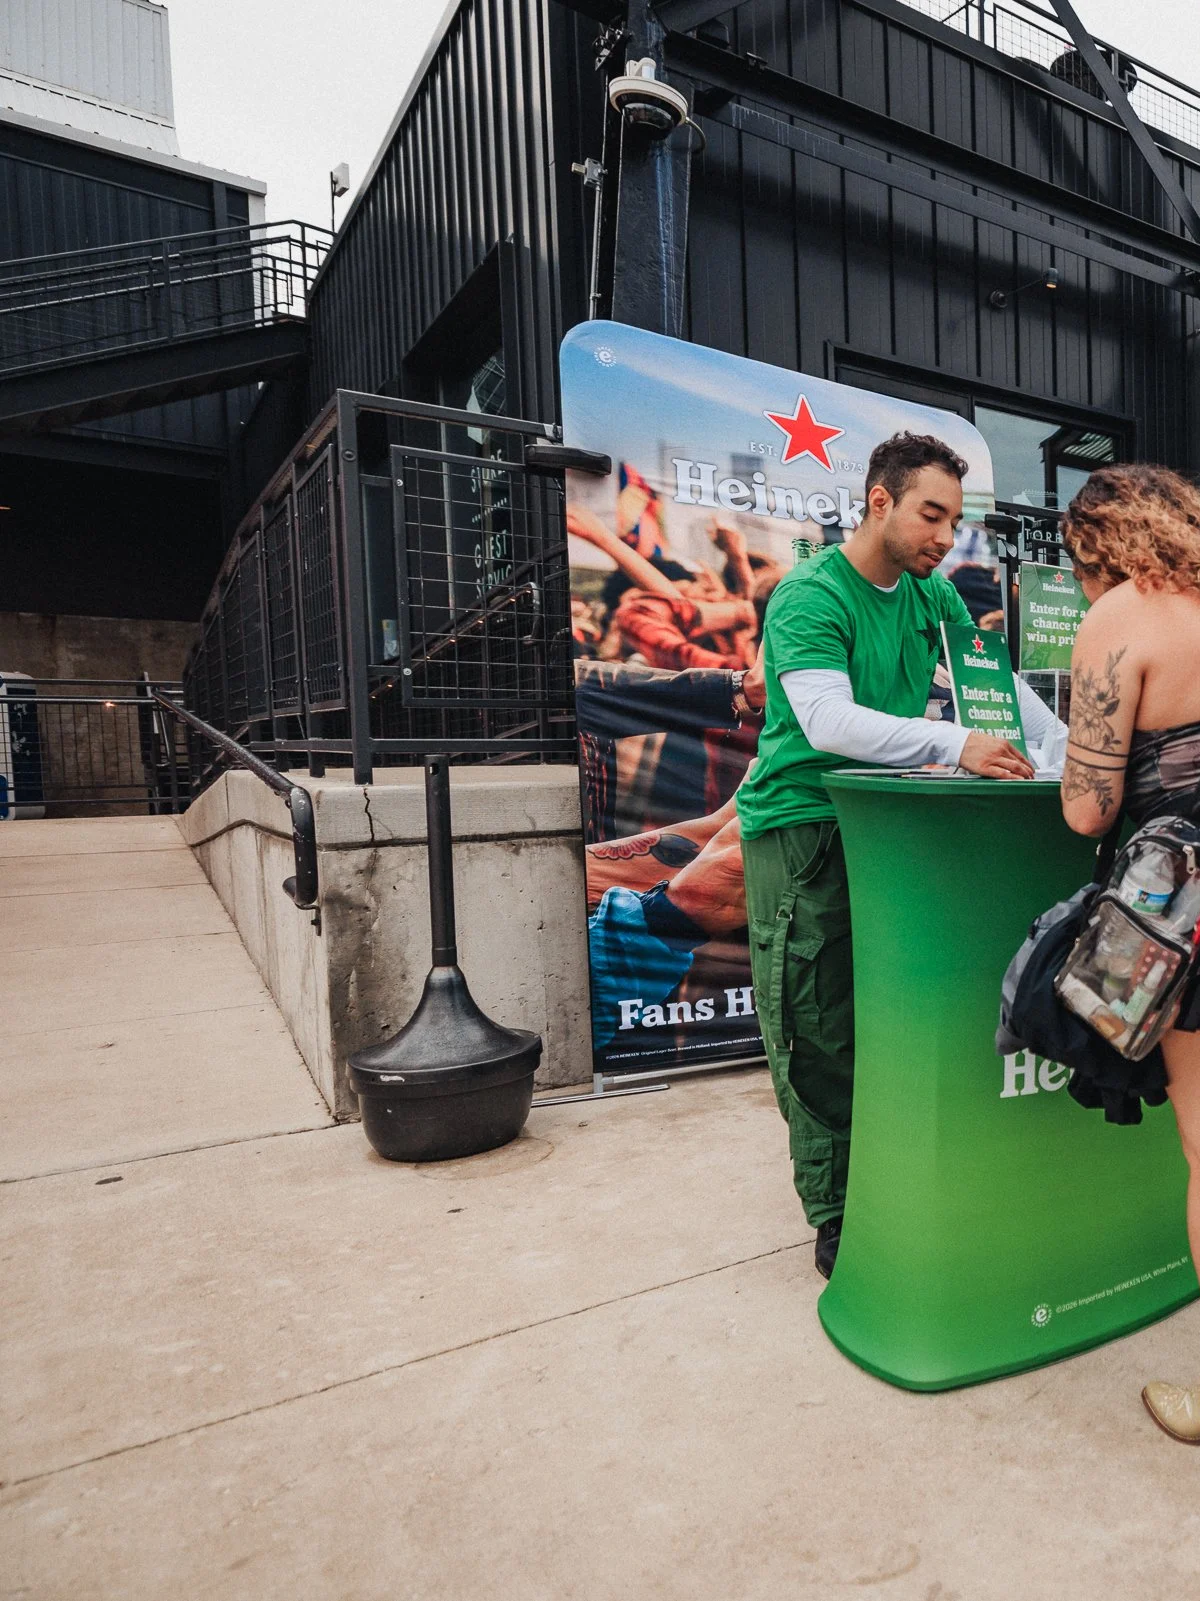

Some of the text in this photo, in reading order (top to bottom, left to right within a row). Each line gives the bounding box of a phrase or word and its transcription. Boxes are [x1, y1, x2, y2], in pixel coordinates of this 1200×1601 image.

[750, 442, 864, 474] EST. 1873
[672, 458, 866, 529] Heinek
[1029, 602, 1086, 618] Enter for a
[1033, 617, 1071, 631] chance
[1026, 631, 1050, 643] win
[1058, 634, 1076, 646] pri
[961, 685, 1013, 703] Enter for a
[968, 705, 1013, 721] chance to
[618, 998, 715, 1031] Fans
[1079, 1291, 1105, 1306] Imported
[1106, 1288, 1113, 1297] by
[1114, 1277, 1141, 1293] HEINEKEN
